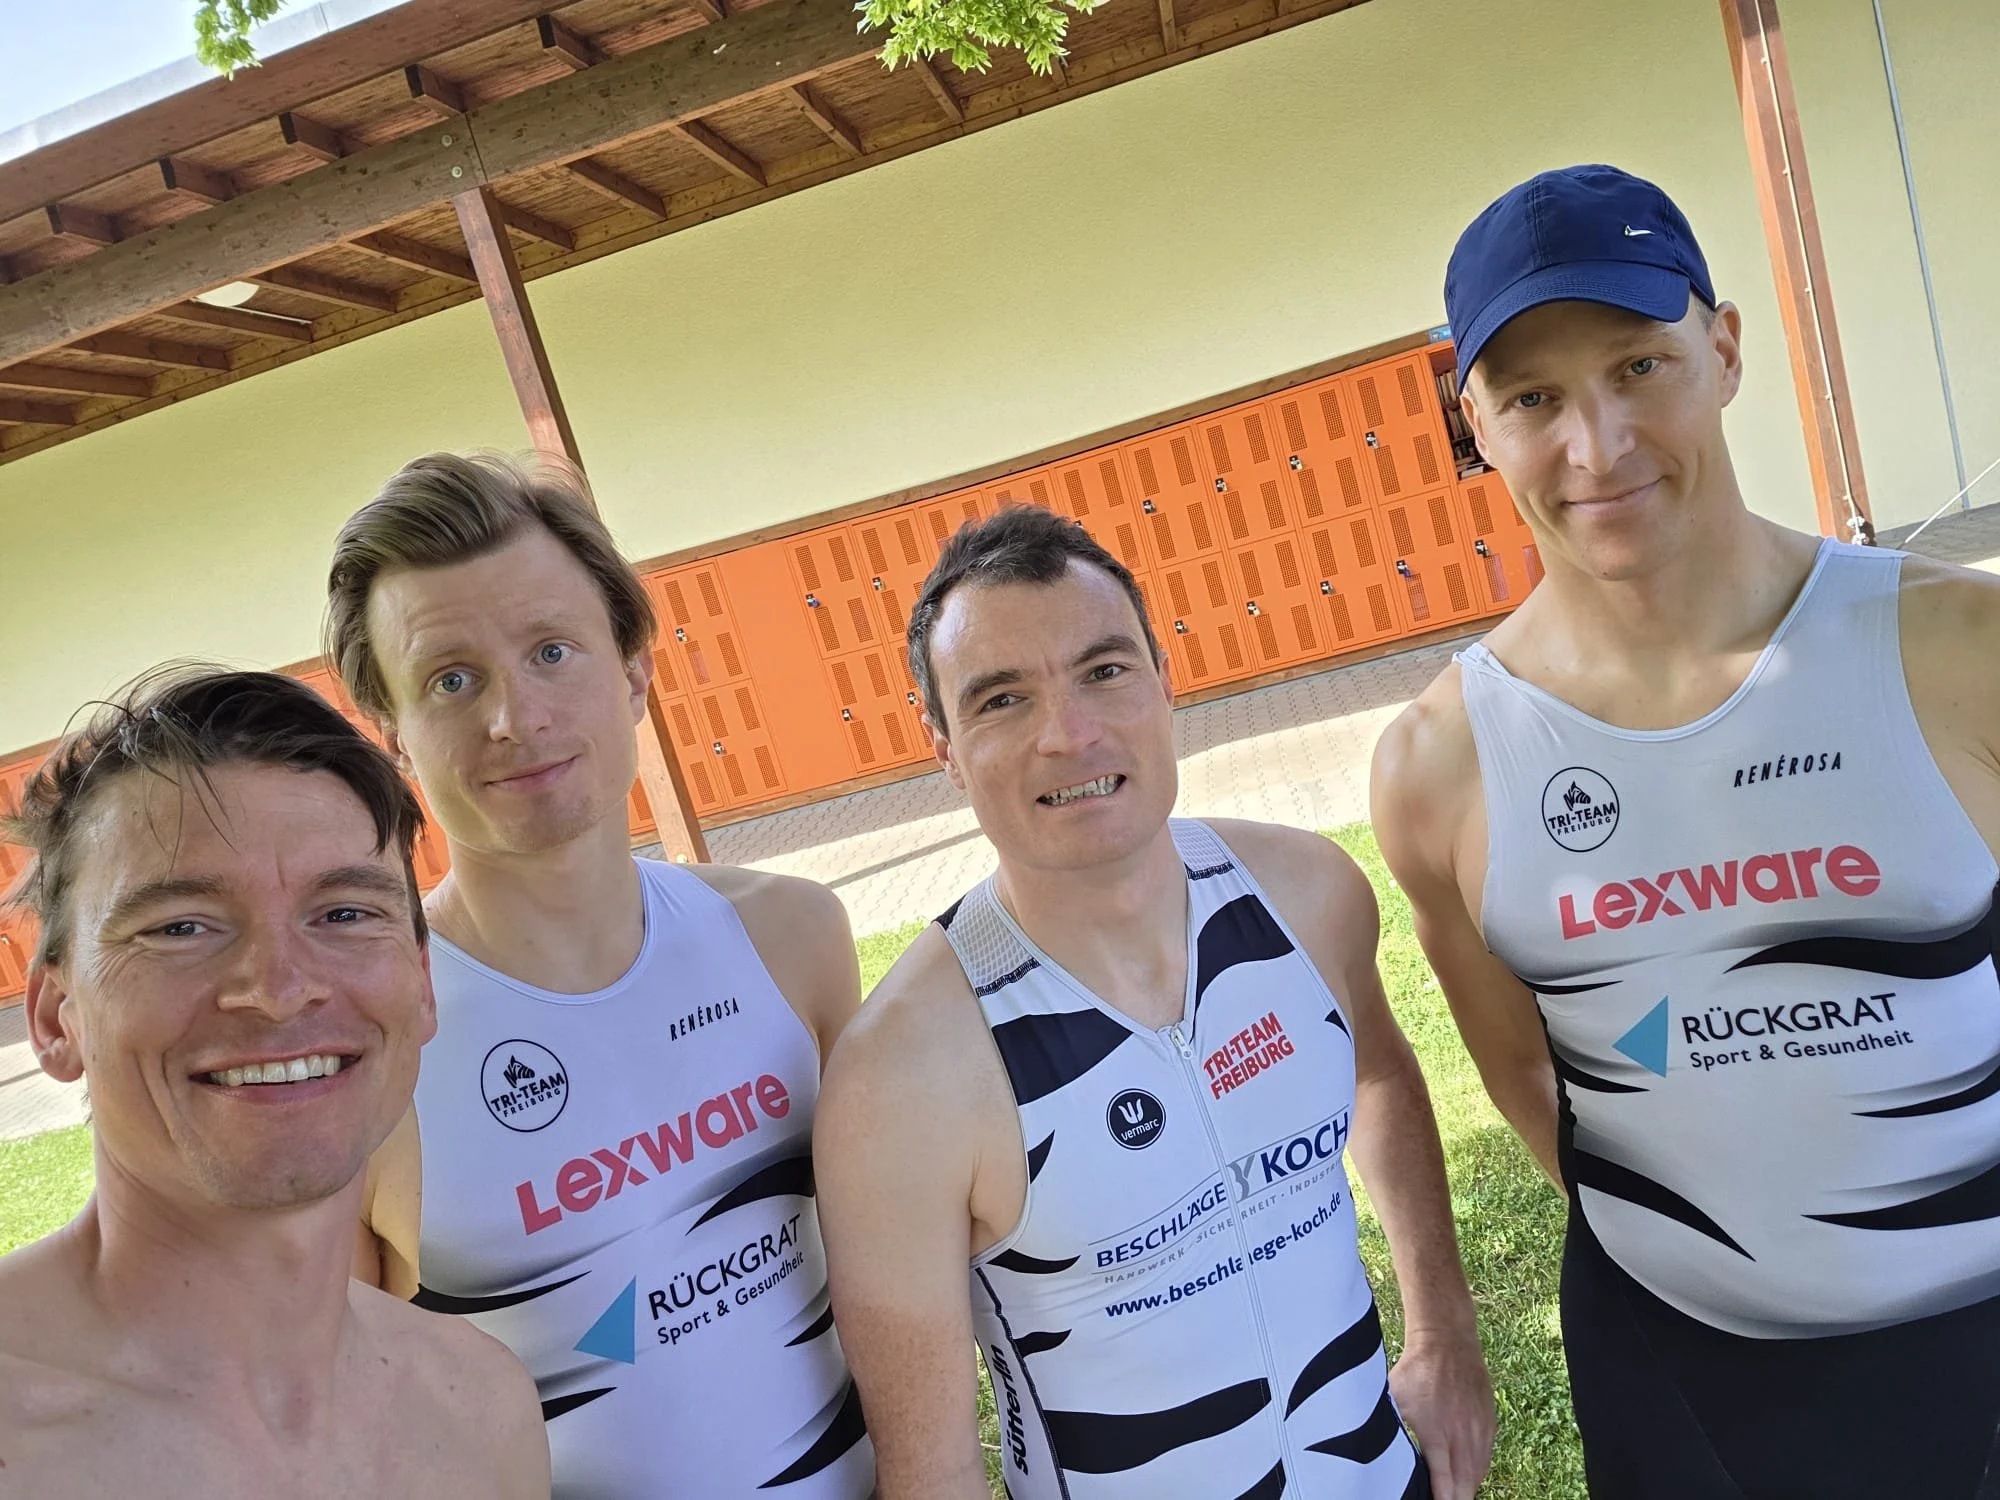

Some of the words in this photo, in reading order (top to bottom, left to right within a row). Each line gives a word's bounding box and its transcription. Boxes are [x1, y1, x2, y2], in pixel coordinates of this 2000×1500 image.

[1733, 751, 1842, 788] RENÉROSA
[1547, 802, 1617, 830] TRI-TEAM
[1557, 816, 1612, 836] FREIBURG
[1557, 844, 1881, 941] Lexware
[669, 997, 740, 1042] RENÉROSA
[1682, 993, 1896, 1045] RÜCKGRAT
[1203, 1011, 1284, 1081] TRI-TEAM
[1210, 1035, 1295, 1101] FREIBURG
[1690, 1047, 1752, 1072] Sport
[1759, 1044, 1776, 1061] &
[1783, 1030, 1914, 1058] Gesundheit
[490, 1072, 566, 1112] TRI-TEAM
[503, 1088, 561, 1118] FREIBURG
[1120, 1117, 1160, 1142] vermarc
[515, 1074, 792, 1236] Lexware
[1289, 1159, 1343, 1196] INDUSTRI
[1096, 1182, 1227, 1268] BESCHLÄGE
[1260, 1111, 1349, 1184] KOCH
[648, 1213, 801, 1321] RÜCKGRAT
[1105, 1191, 1341, 1317] www.beschlaege-koch.de
[657, 1310, 712, 1345] Sport
[716, 1298, 731, 1317] &
[734, 1251, 804, 1306] Gesundheit
